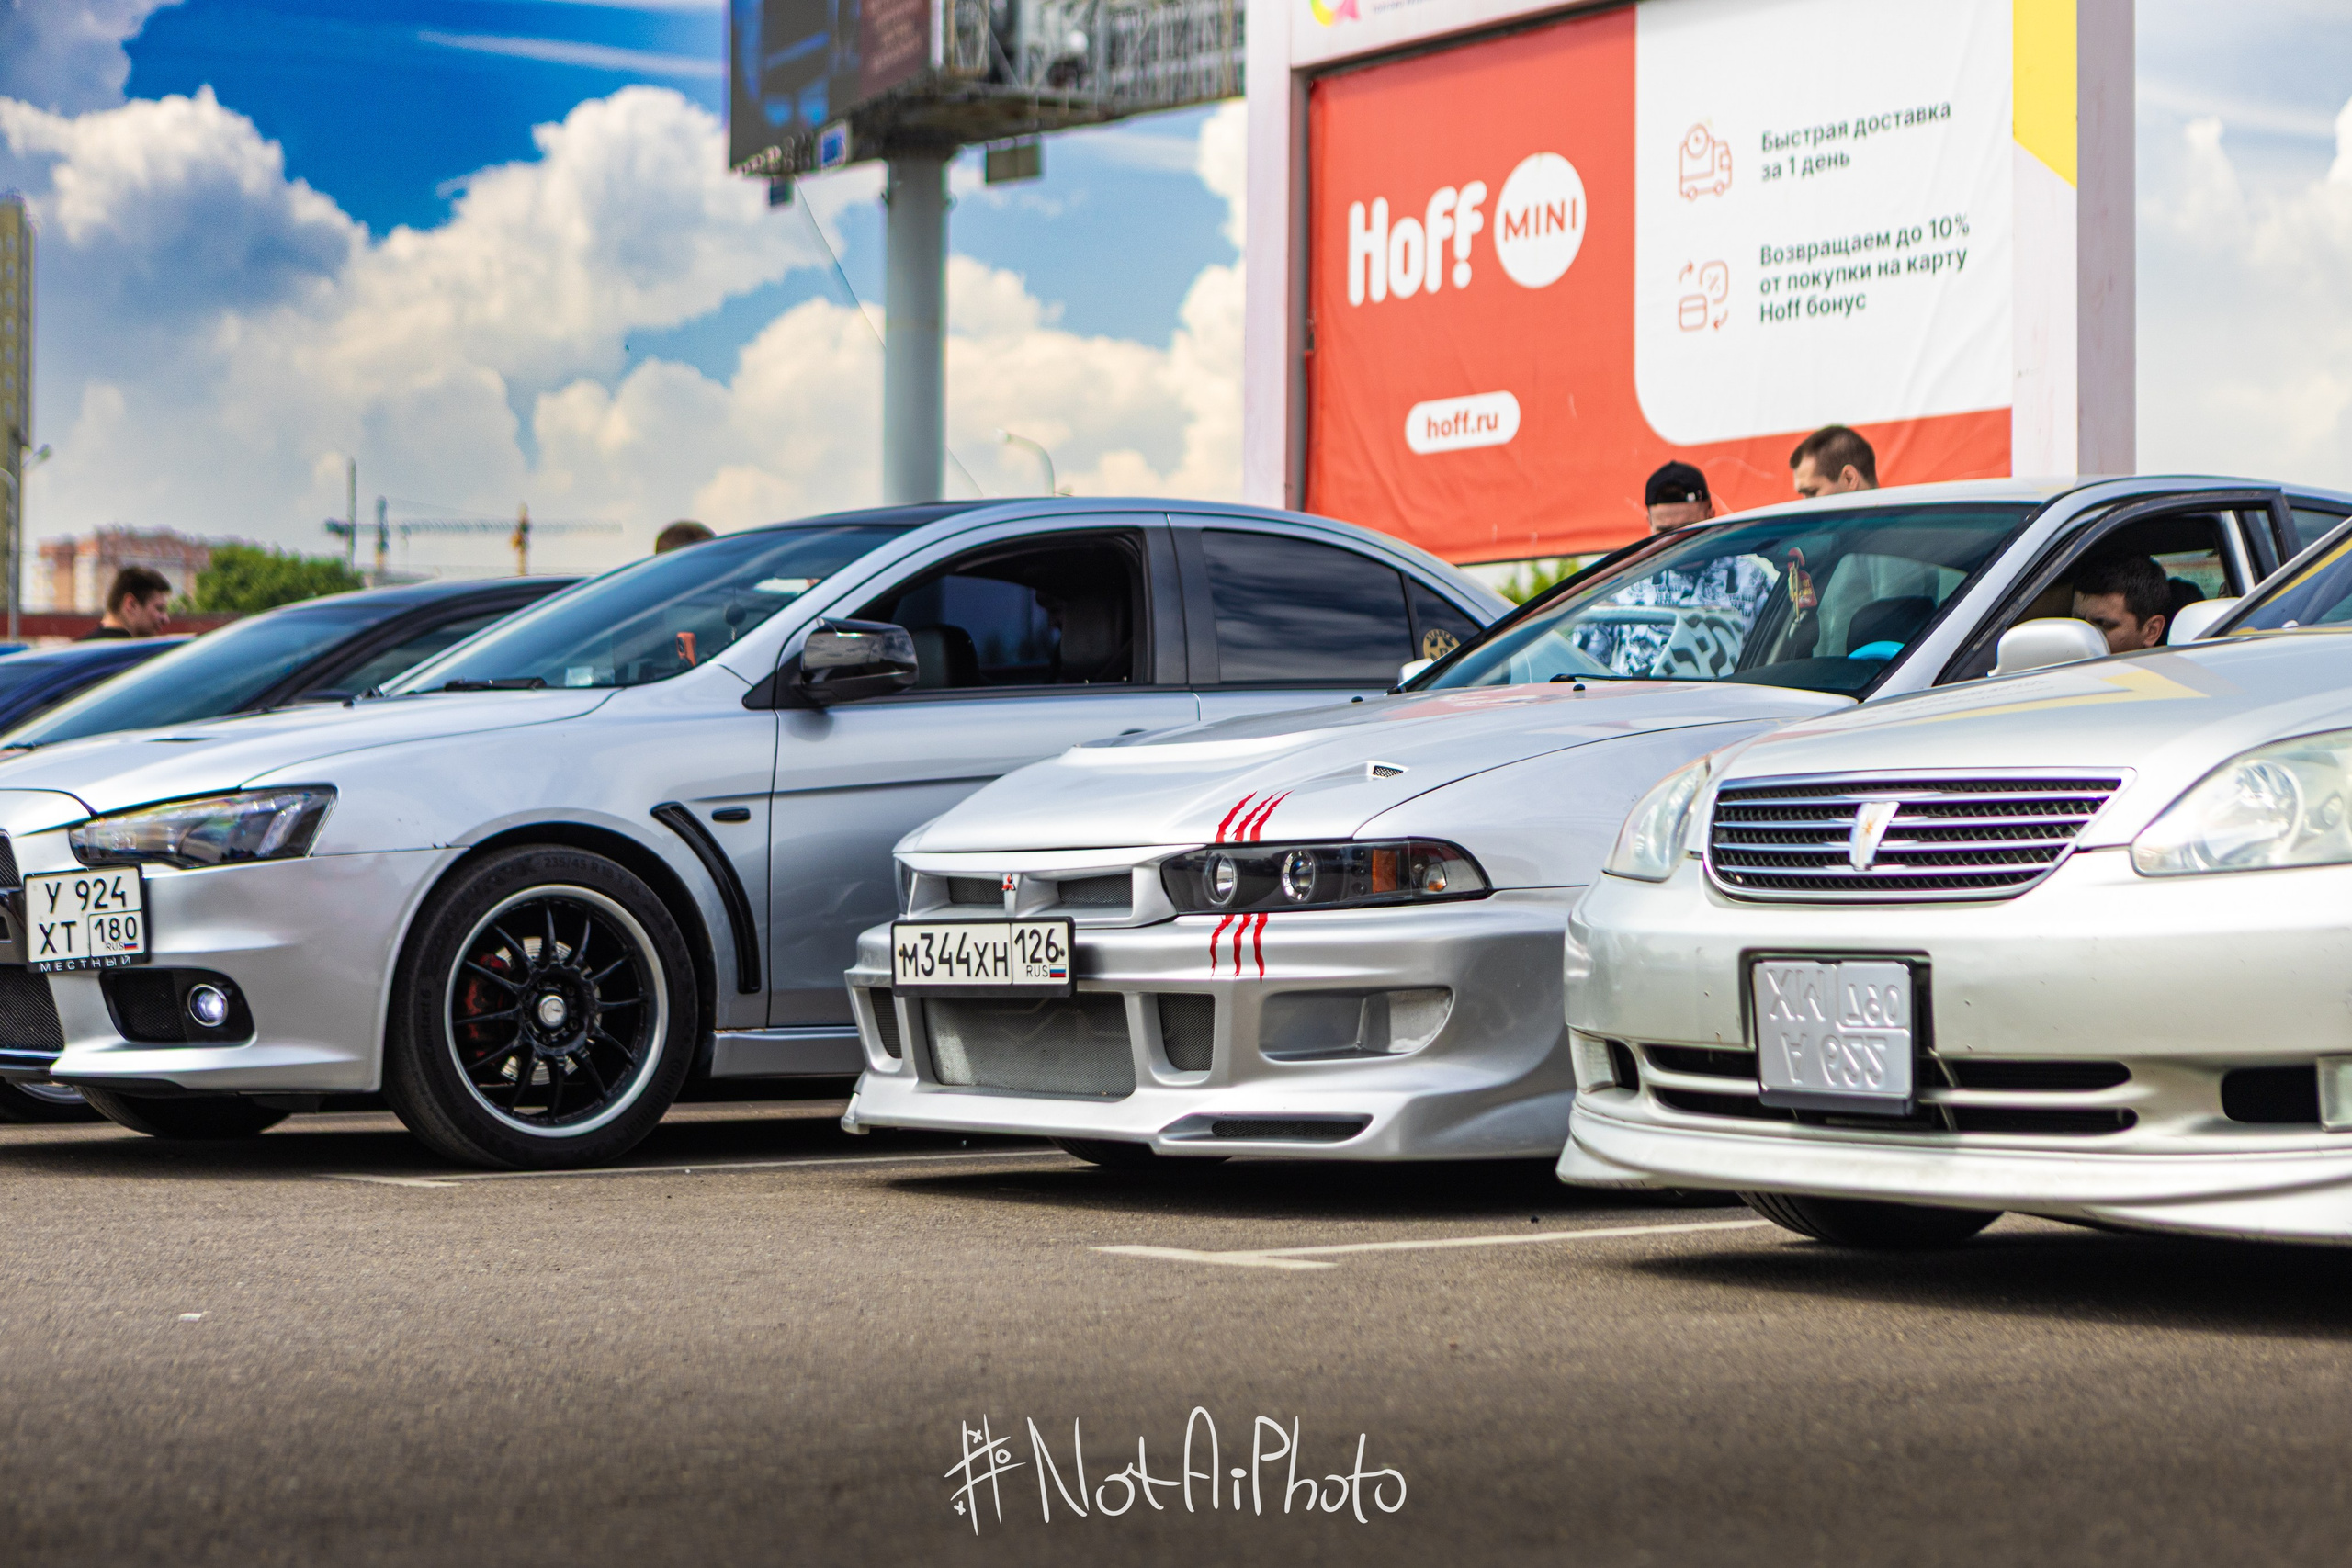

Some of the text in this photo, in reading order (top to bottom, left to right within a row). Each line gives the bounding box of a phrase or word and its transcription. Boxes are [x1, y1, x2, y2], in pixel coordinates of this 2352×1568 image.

[1761, 101, 1951, 152] Быстрая доставка
[1761, 151, 1850, 182] за 1 день
[1504, 196, 1577, 243] MINI
[1760, 212, 1970, 266] Возвращаем до 10%
[1760, 247, 1968, 295] от покупки на карту
[1760, 291, 1866, 323] Hoff бонус
[1426, 410, 1499, 439] hoff.ru
[45, 876, 127, 914] У 924
[39, 916, 137, 955] ХТ 180
[106, 942, 124, 951] RUS
[902, 928, 1060, 977] М344ХН 126
[40, 955, 131, 973] МЕСТНЫЙ
[1026, 965, 1048, 977] RUS
